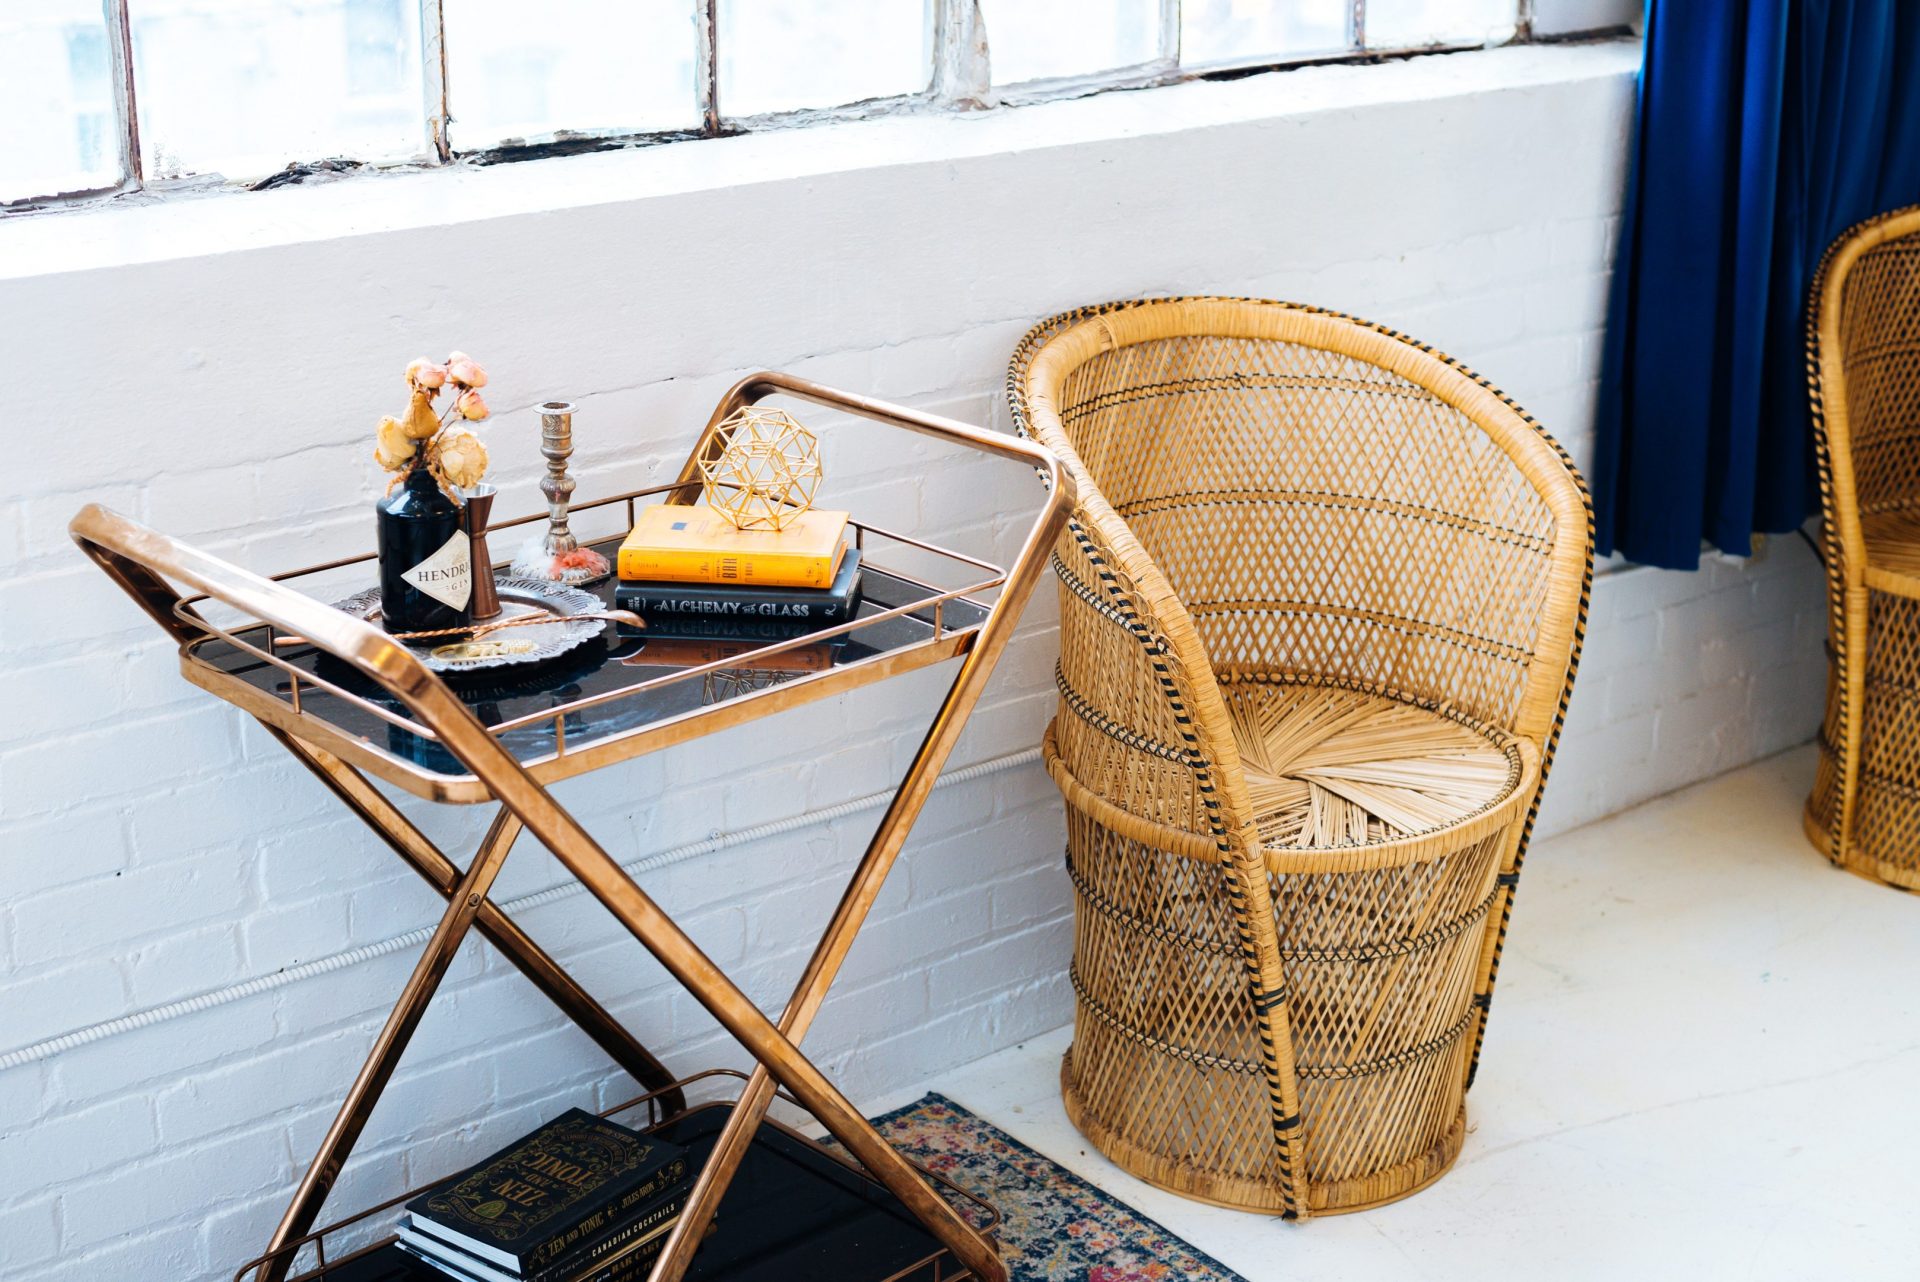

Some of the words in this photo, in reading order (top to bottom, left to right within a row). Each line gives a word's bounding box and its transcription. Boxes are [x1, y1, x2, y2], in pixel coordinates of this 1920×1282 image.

[418, 561, 470, 581] HENDRI
[654, 599, 741, 615] ALCHEMY
[758, 602, 810, 617] GLASS
[521, 1151, 595, 1188] TONIC
[524, 1173, 554, 1188] AND
[490, 1178, 549, 1207] ZEN
[548, 1235, 566, 1257] ZEN
[566, 1228, 579, 1244] AND
[578, 1211, 605, 1237] TONIC
[621, 1189, 640, 1209] JULES
[592, 1229, 632, 1257] CANADIAN
[633, 1202, 675, 1233] COCKTAILS
